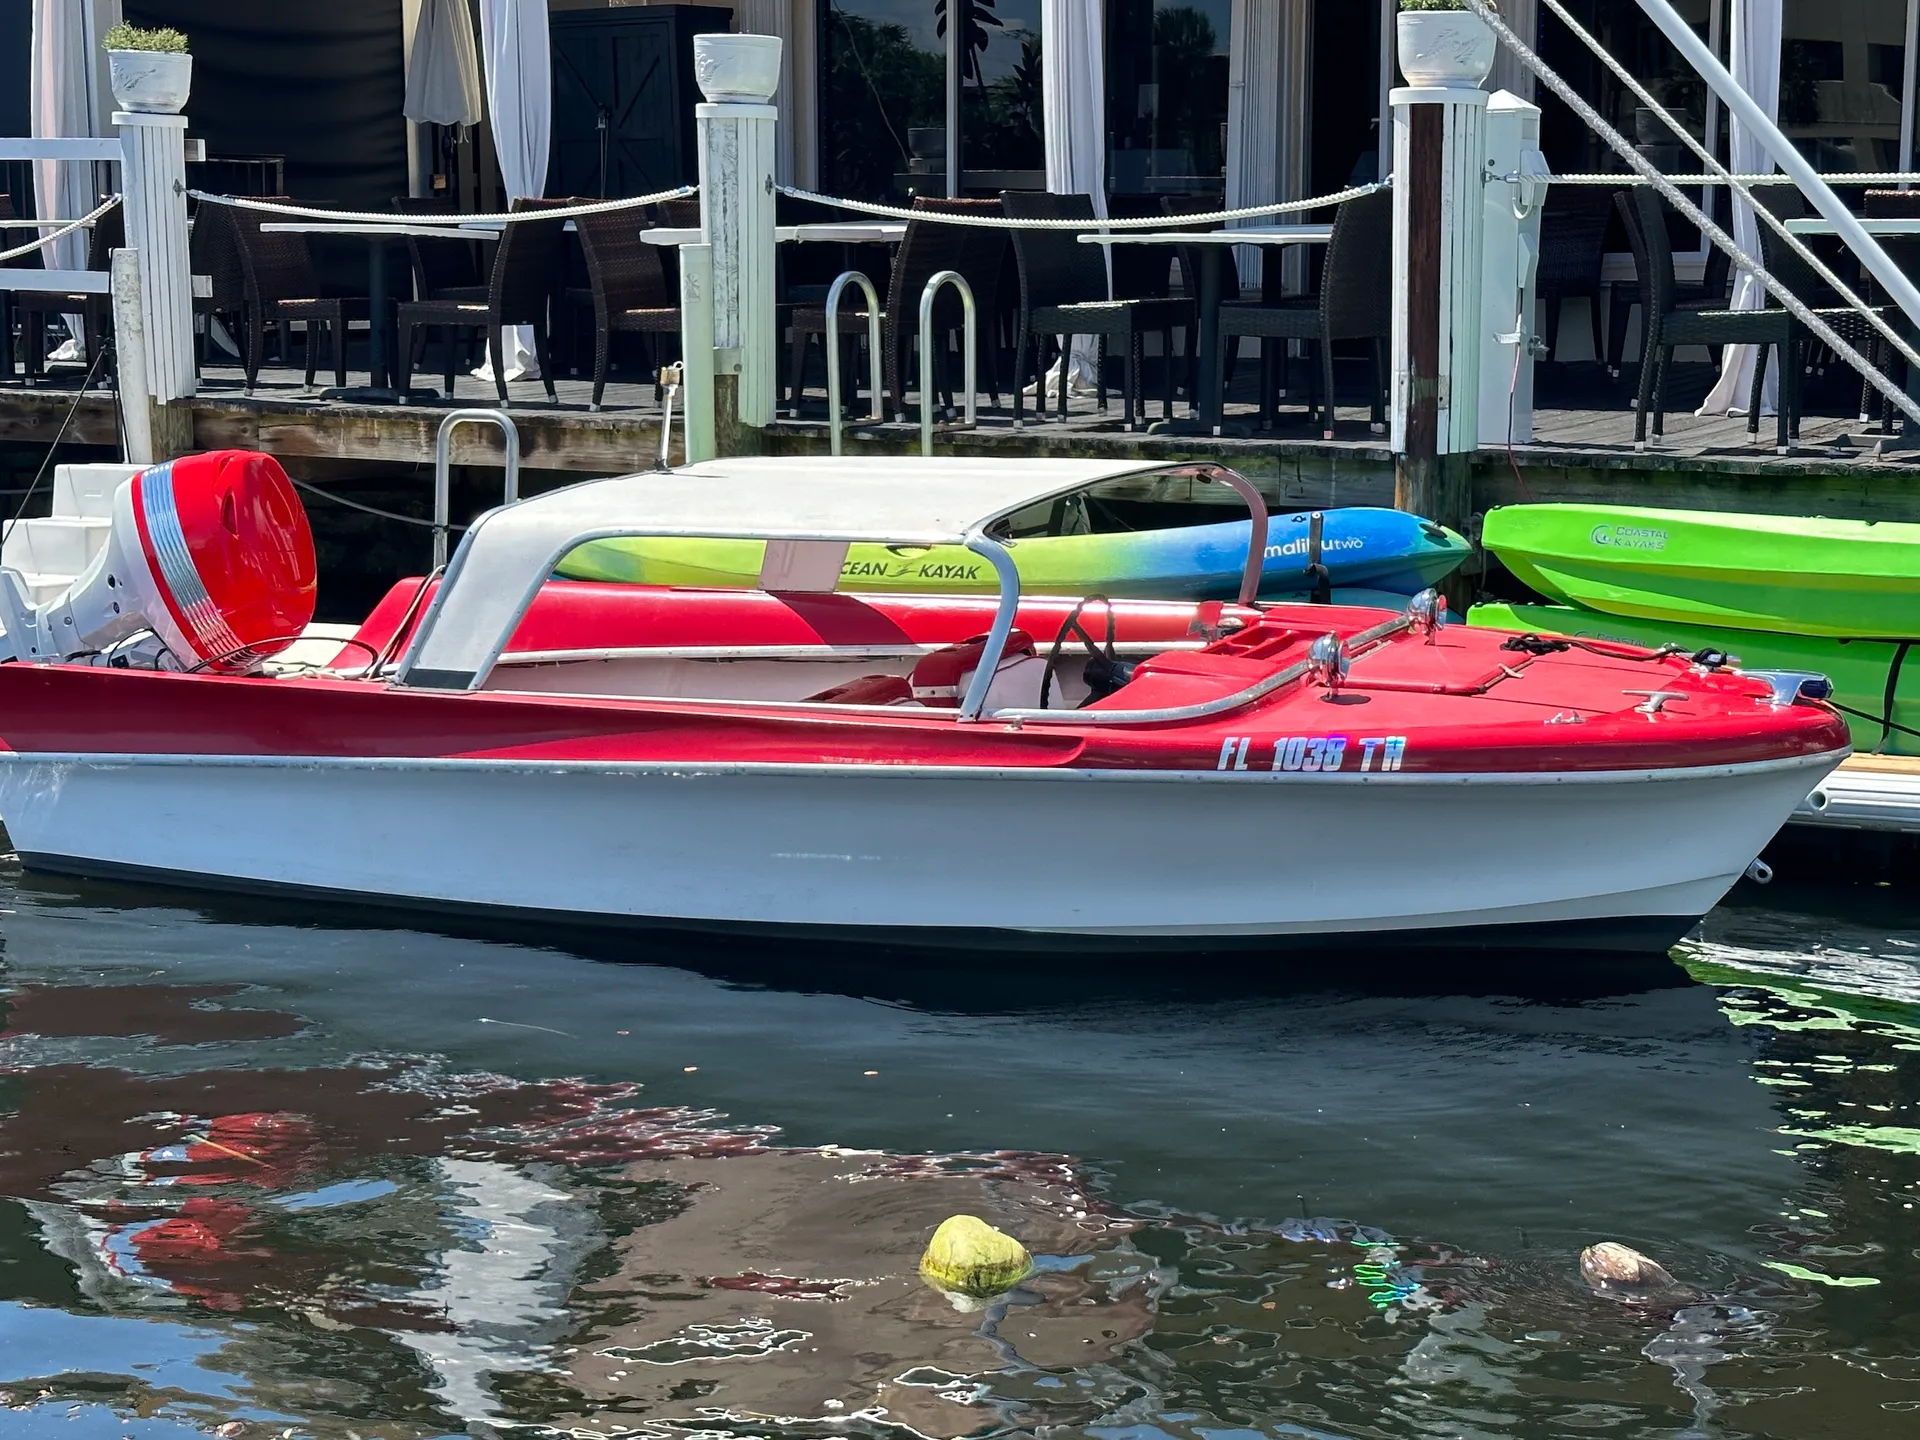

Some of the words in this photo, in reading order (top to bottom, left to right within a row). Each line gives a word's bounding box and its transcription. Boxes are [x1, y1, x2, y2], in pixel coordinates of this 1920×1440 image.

[1616, 526, 1669, 539] COASTAL
[1264, 536, 1334, 558] maliu
[1613, 537, 1664, 550] KAYAKS
[840, 561, 888, 576] CEAN
[918, 563, 981, 580] KAYAK
[1217, 736, 1251, 771] FL
[1271, 736, 1348, 772] 1038
